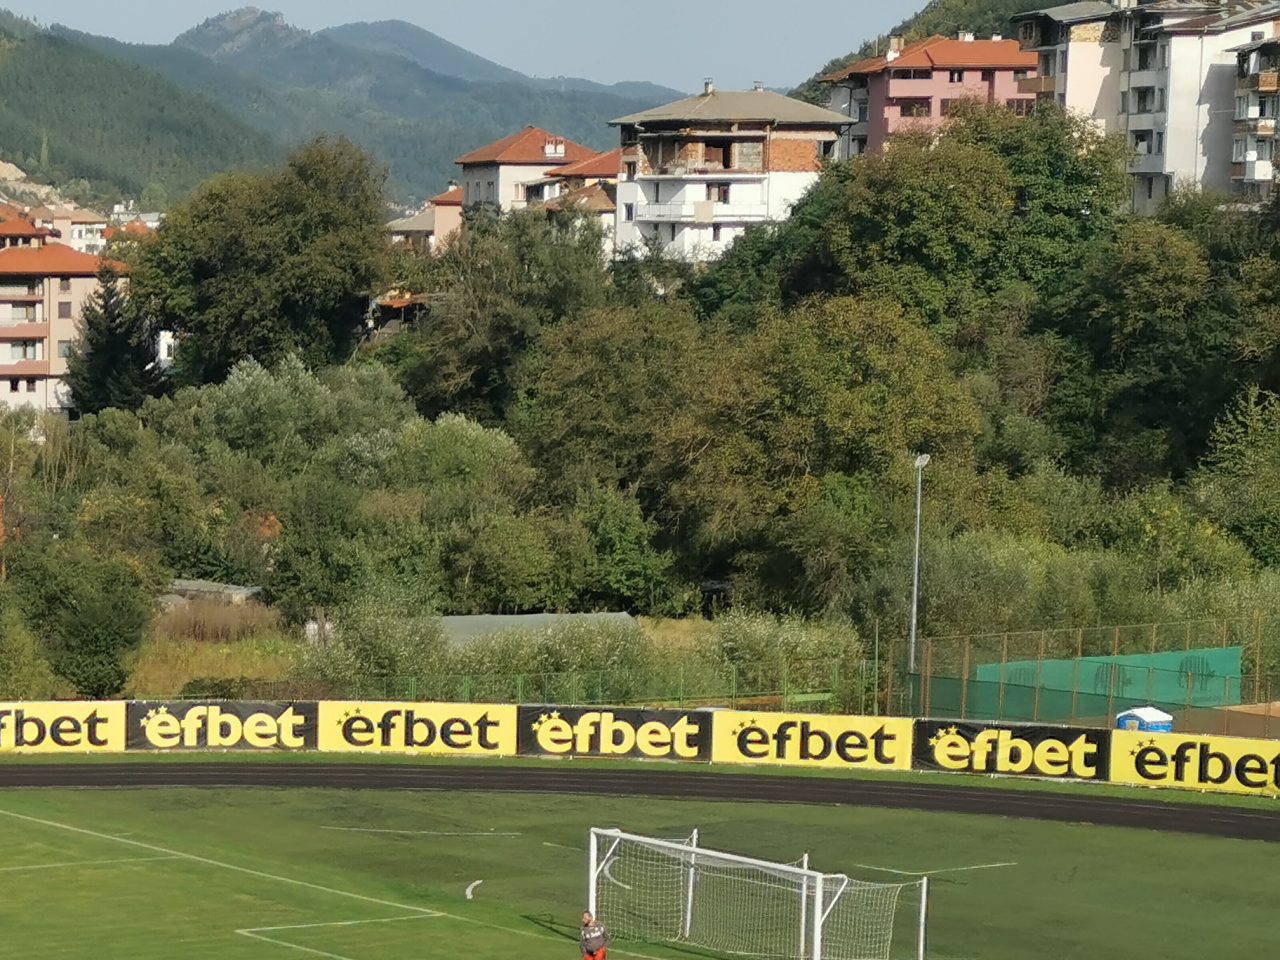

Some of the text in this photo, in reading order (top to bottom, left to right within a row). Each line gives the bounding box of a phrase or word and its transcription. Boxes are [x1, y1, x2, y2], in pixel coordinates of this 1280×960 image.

[145, 706, 305, 747] efbet
[341, 710, 500, 750] efbet
[537, 711, 700, 757] efbet
[736, 720, 896, 764] efbet
[933, 730, 1097, 778] efbet
